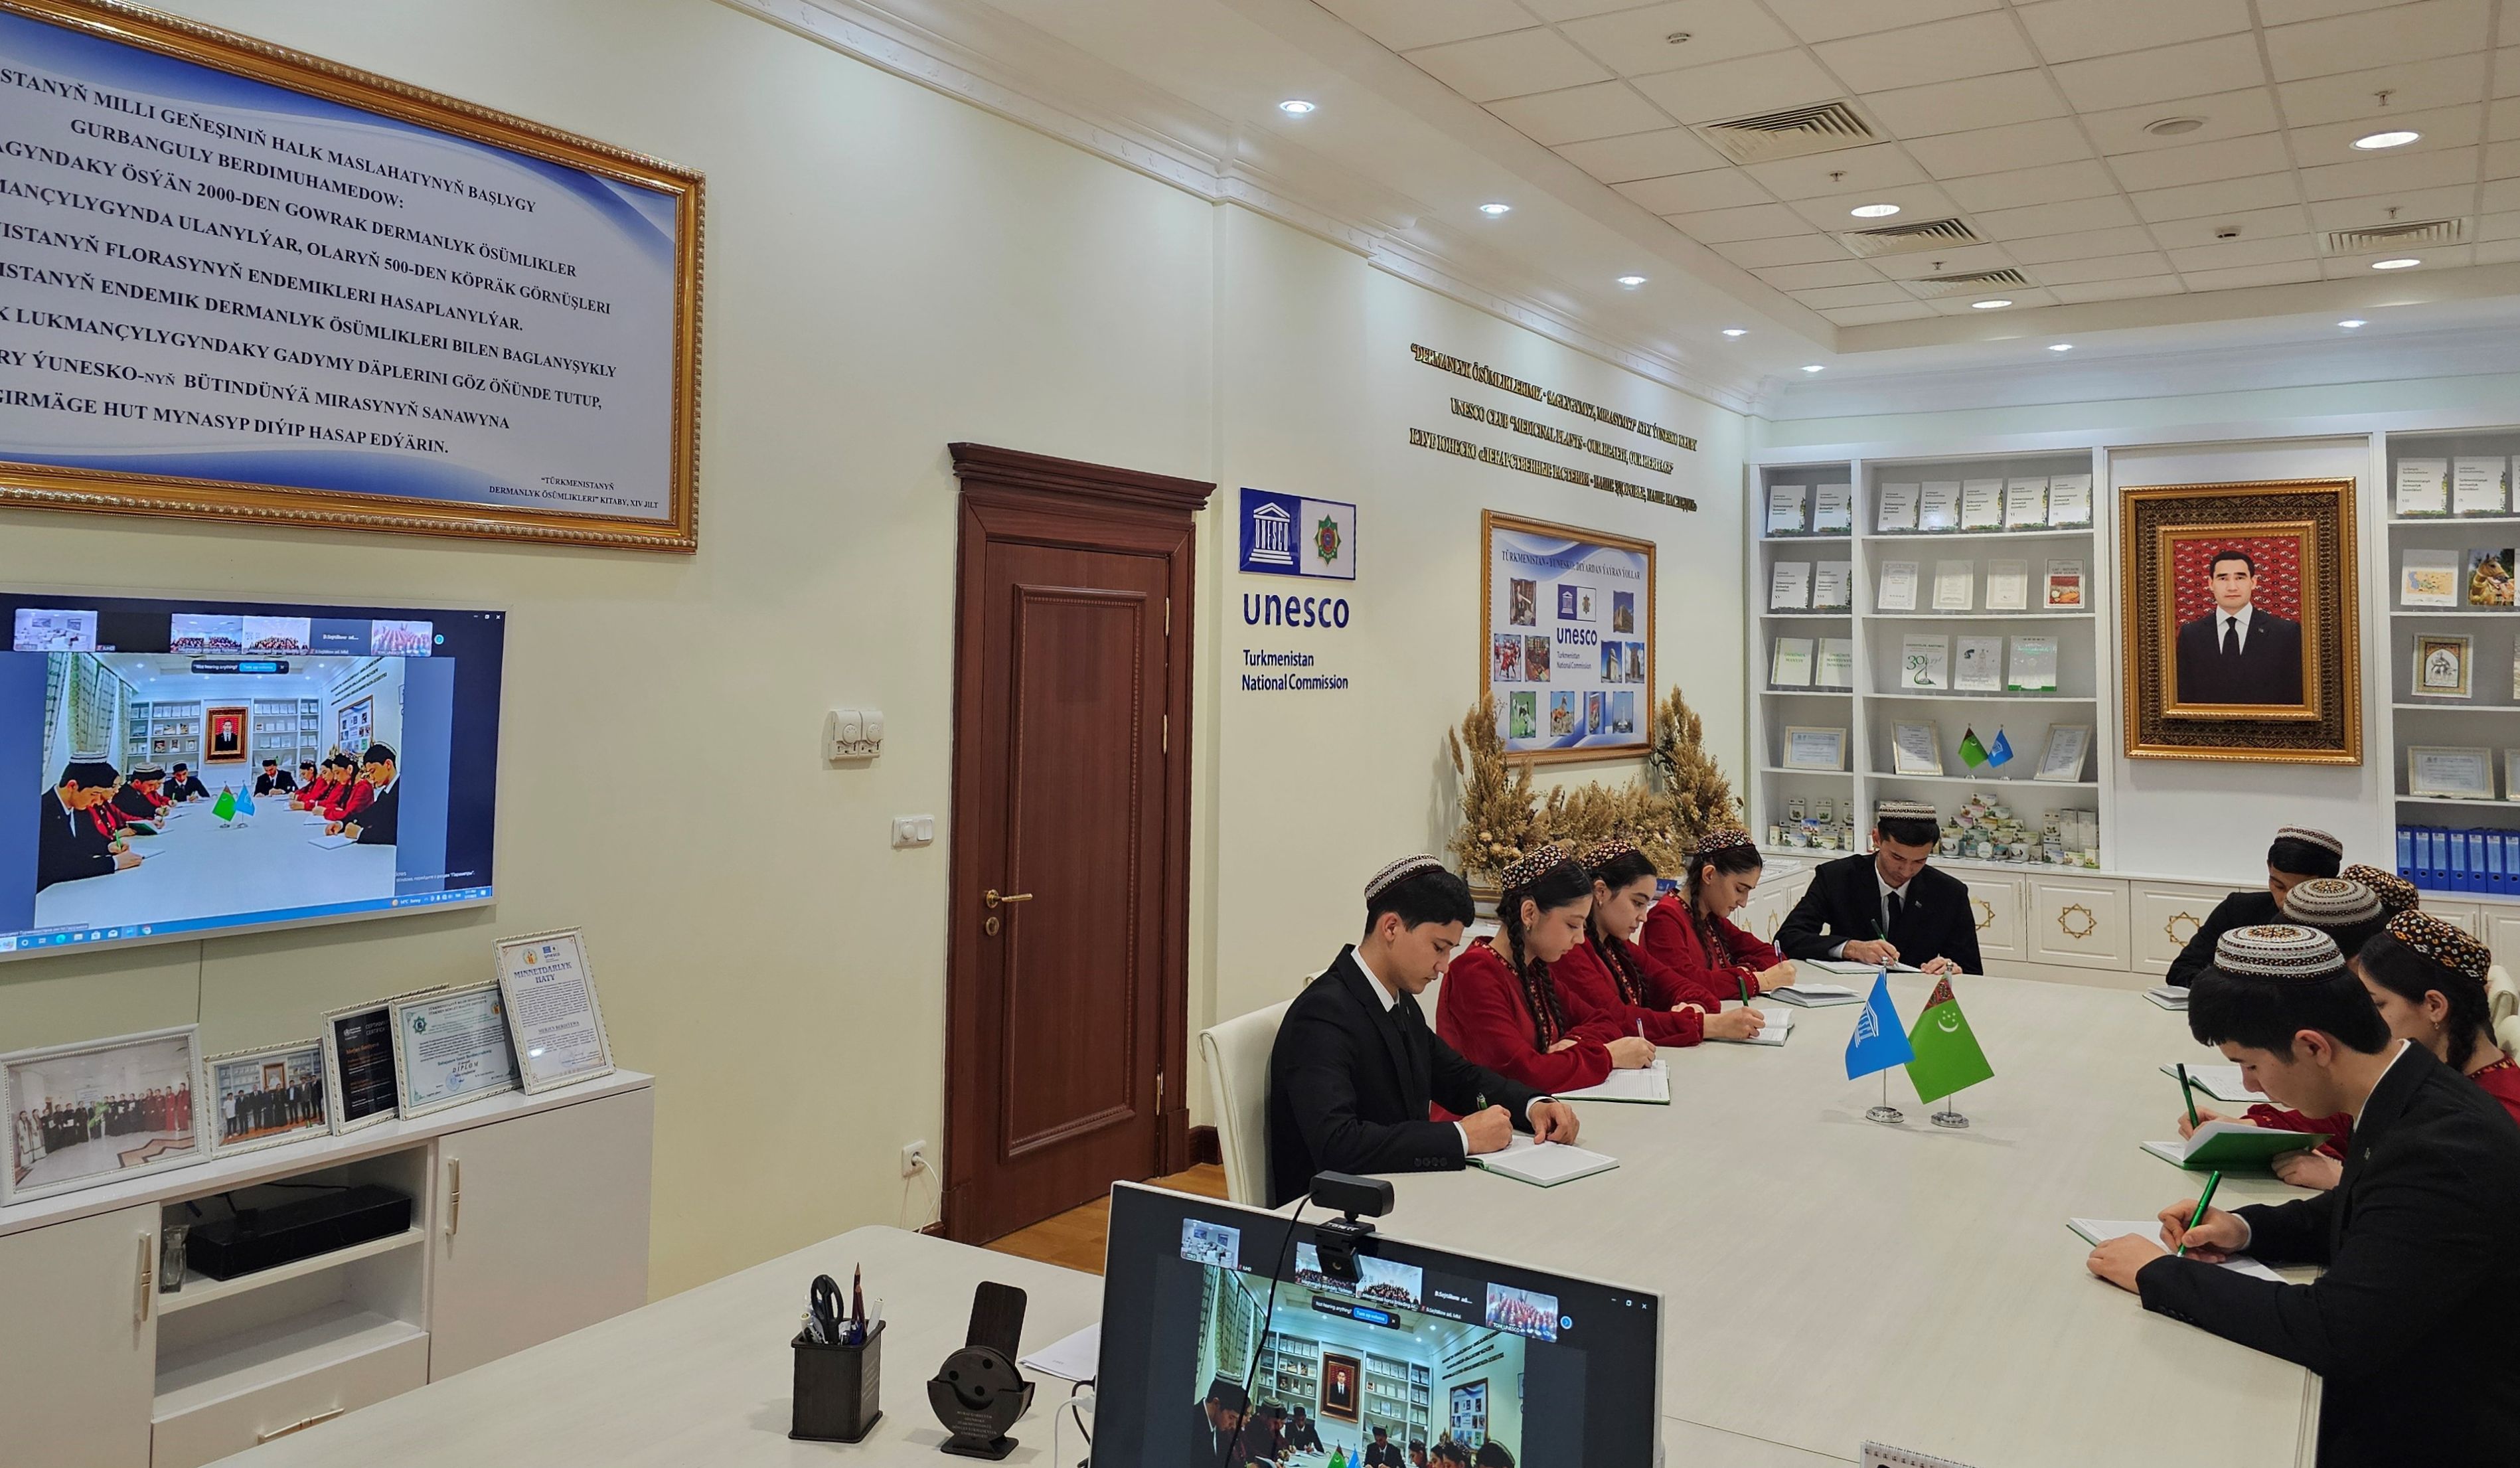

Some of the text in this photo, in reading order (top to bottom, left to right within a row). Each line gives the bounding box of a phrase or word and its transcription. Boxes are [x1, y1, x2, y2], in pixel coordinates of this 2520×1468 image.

[71, 120, 403, 208] GURBANGULY BERDIMUHAMEDOW:
[94, 91, 155, 119] MILLI
[161, 110, 267, 146] GEŇEŞINIŇ
[272, 136, 323, 161] HALK
[327, 150, 464, 195] MASLAHATYNYŇ
[468, 185, 536, 212] BAŞLYGY
[122, 163, 191, 193] ÖSÝÄN
[197, 183, 280, 212] 2000-DEN
[285, 203, 368, 232] GOWRAK
[372, 221, 475, 255] DERMANLYK
[479, 243, 577, 277] ÖSÜMLIKLER
[0, 222, 522, 331] ISTANYŇ FLORASYNYŇ ENDEMIKLERI HASAPLANYLÝAR.
[179, 215, 302, 255] ULANYLÝAR,
[307, 242, 380, 268] OLARYŇ
[384, 258, 447, 281] 500-DEN
[451, 271, 516, 295] KÖPRÄK
[520, 285, 610, 314] GÖRNÜŞLERI
[16, 308, 270, 359] LUKMANÇYLYGYNDAKY
[274, 348, 354, 371] GADYMY
[358, 359, 448, 385] DÄPLERINI
[452, 374, 486, 391] GÖZ
[489, 378, 551, 400] ÖŇÜNDE
[554, 390, 601, 410] TUTUP,
[101, 280, 200, 309] ENDEMIK
[205, 297, 325, 329] DERMANLYK
[330, 316, 448, 350] ÖSÜMLIKLERI
[452, 339, 499, 358] BILEN
[503, 347, 616, 377] BAGLANYŞYKLY
[0, 390, 448, 453] IRMÄGE HUT MYNASYP DIÝIP HASAP EDÝÄRIN.
[32, 351, 175, 386] ÝUNESKO-NYŇ
[184, 373, 310, 403] BÜTINDÜNÝÄ
[315, 392, 418, 417] MIRASYNYŇ
[422, 406, 509, 429] SANAWYNA
[1451, 398, 1484, 422] UNESCO
[1486, 408, 1509, 429] CLUB
[1556, 429, 1583, 449] PLANTS
[1587, 439, 1602, 453] OUR
[1602, 442, 1628, 465] HEALTH,
[1628, 450, 1642, 467] OUR
[489, 485, 540, 498] DERMANLYK
[600, 496, 629, 507] KITABY,
[1410, 428, 1437, 449] КЛУБ
[1437, 435, 1477, 460] ЮНЕСКО
[1553, 464, 1590, 487] РАСТЕНИЯ
[1593, 474, 1614, 492] НАШЕ
[1614, 479, 1646, 503] ЗДОРОВЬЕ,
[1646, 488, 1666, 505] НАШЕ
[1255, 519, 1289, 552] UNESCO
[1243, 593, 1350, 629] unesco
[1557, 626, 1598, 646] unesco
[1242, 674, 1349, 691] National Commission
[1243, 649, 1314, 667] Turkmenistan
[514, 962, 572, 979] MINNETDARLYK
[535, 973, 556, 984] HATY
[452, 1062, 479, 1073] DIPLOM
